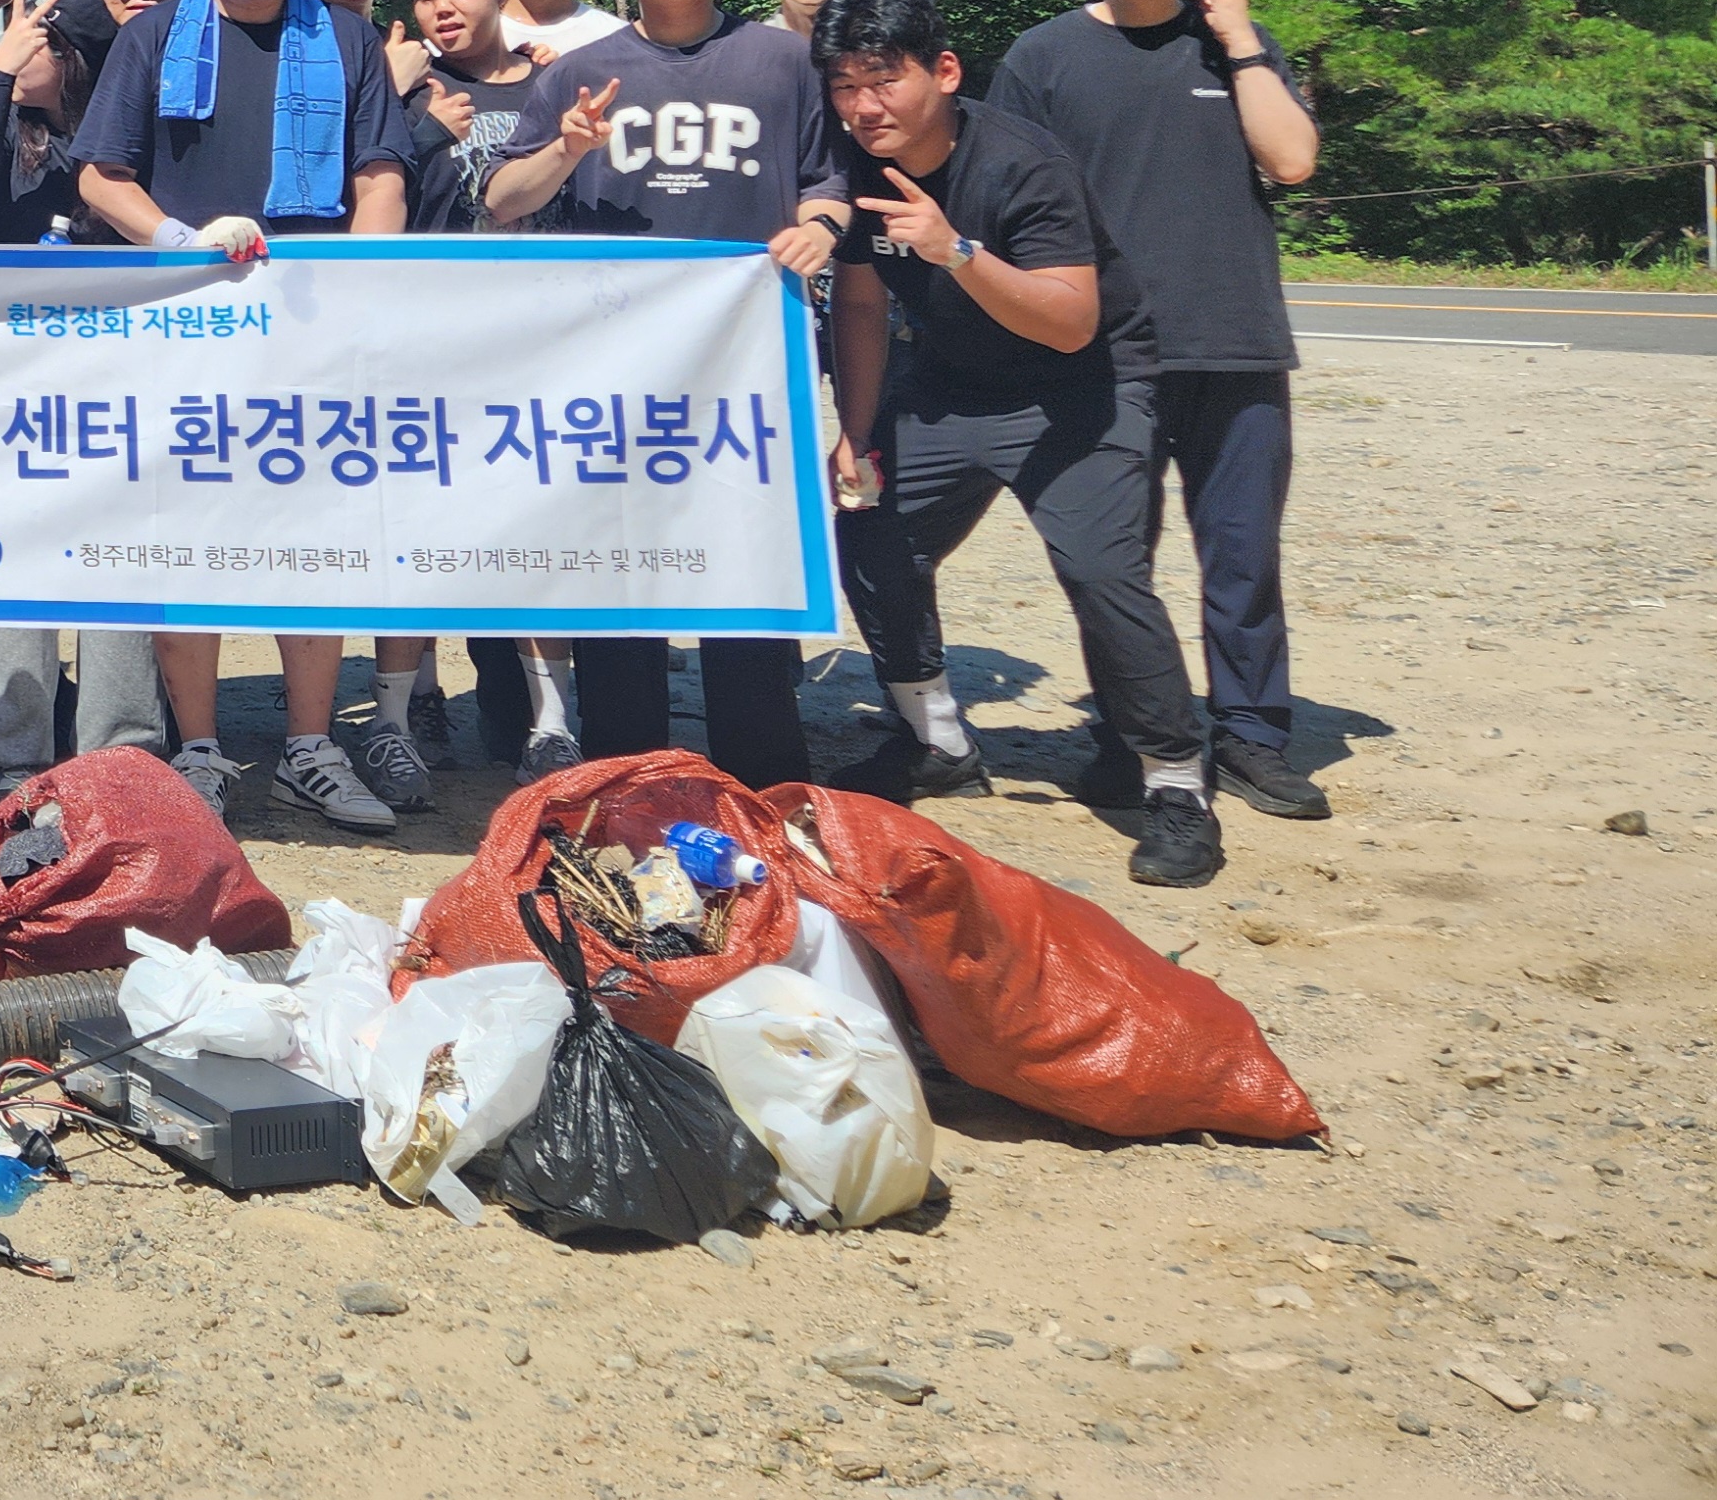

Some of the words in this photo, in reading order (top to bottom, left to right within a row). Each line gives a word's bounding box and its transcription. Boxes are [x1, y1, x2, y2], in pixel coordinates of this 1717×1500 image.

[609, 101, 761, 177] CGP.
[6, 302, 135, 340] 환경정화
[141, 301, 274, 340] 자원봉사
[168, 393, 458, 487] 환경정화
[484, 393, 776, 485] 자원봉사
[79, 543, 197, 569] 청주대학교
[204, 545, 371, 573] 항공기계공학과
[410, 548, 553, 574] 항공기계학과
[559, 549, 604, 573] 교수
[611, 548, 630, 573] 및
[638, 548, 707, 574] 재학생
